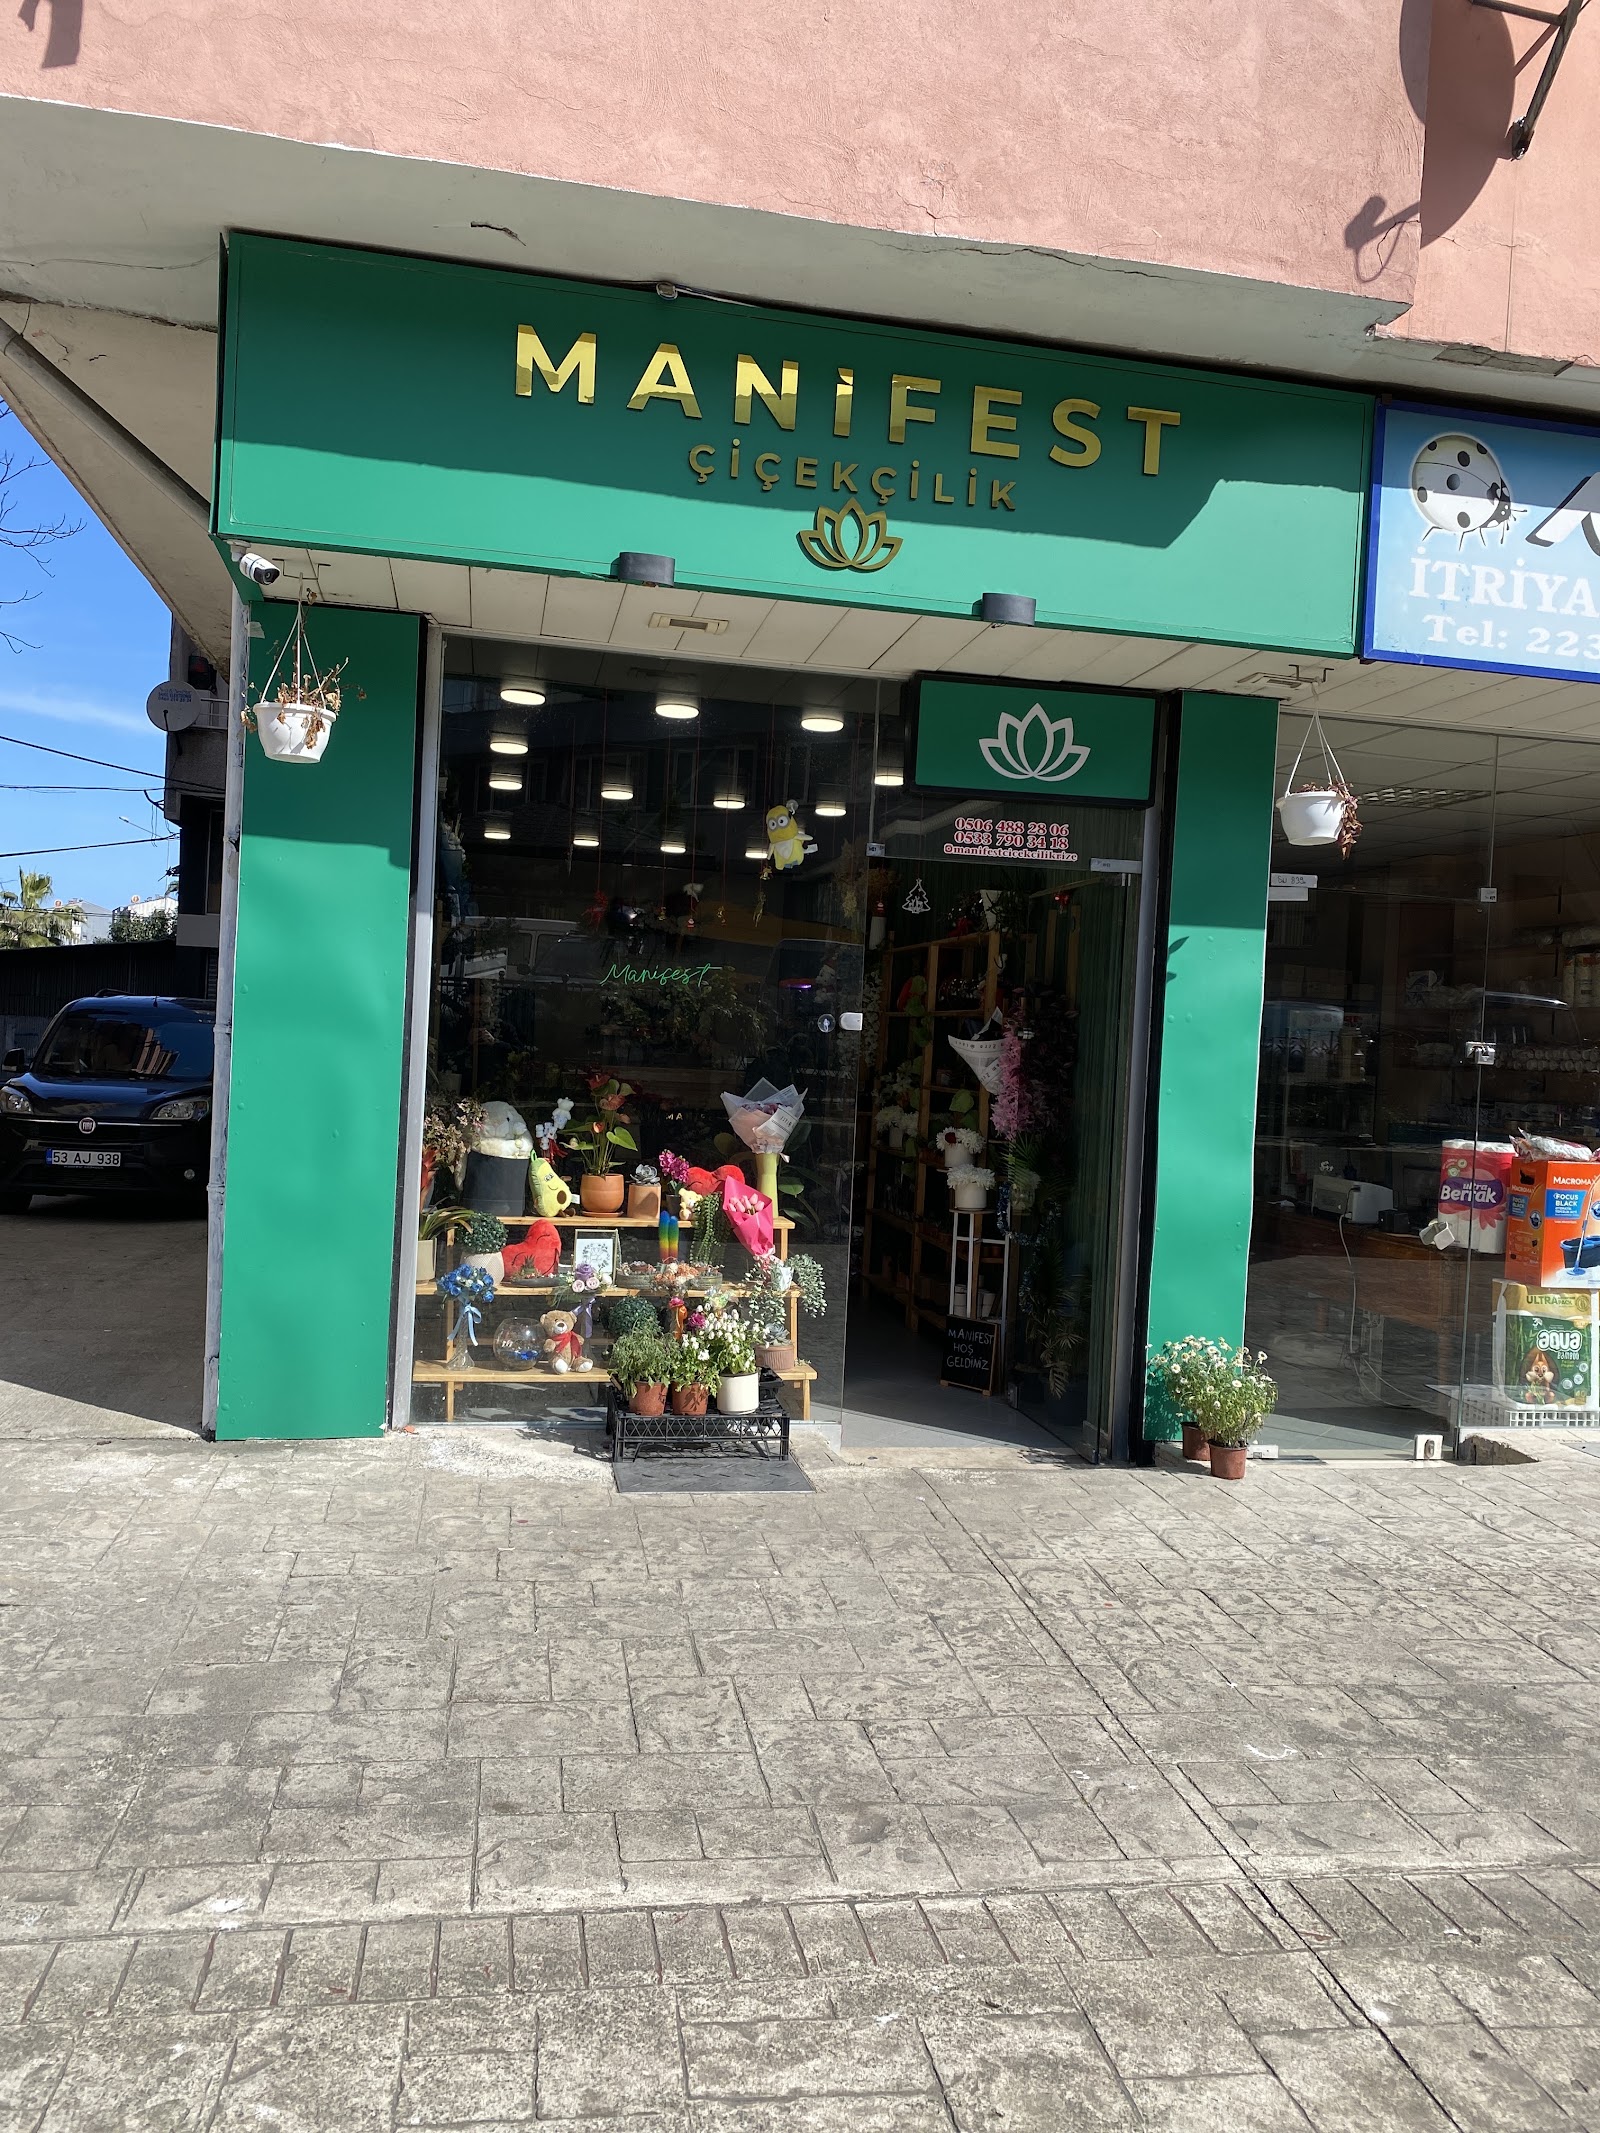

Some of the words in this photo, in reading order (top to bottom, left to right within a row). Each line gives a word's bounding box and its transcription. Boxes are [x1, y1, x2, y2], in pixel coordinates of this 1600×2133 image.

[688, 438, 1017, 511] ÇİÇEKÇİLİK
[1421, 614, 1508, 650] Tel:
[954, 817, 993, 832] 0506
[995, 820, 1025, 834] 488
[1027, 822, 1047, 835] 28
[1049, 823, 1069, 836] 06
[953, 830, 992, 845] 0533
[995, 833, 1025, 847] 790
[1026, 835, 1047, 848] 34
[1049, 836, 1069, 850] 18
[599, 963, 723, 988] Manifest
[53, 1151, 68, 1163] 53
[73, 1152, 92, 1164] AJ
[97, 1153, 120, 1165] 938
[1463, 1181, 1488, 1191] ulra
[1556, 1193, 1579, 1201] FOCUS
[1526, 1295, 1558, 1305] ULTRA
[947, 1328, 995, 1345] MANIFEST
[953, 1342, 974, 1357] HOŞ
